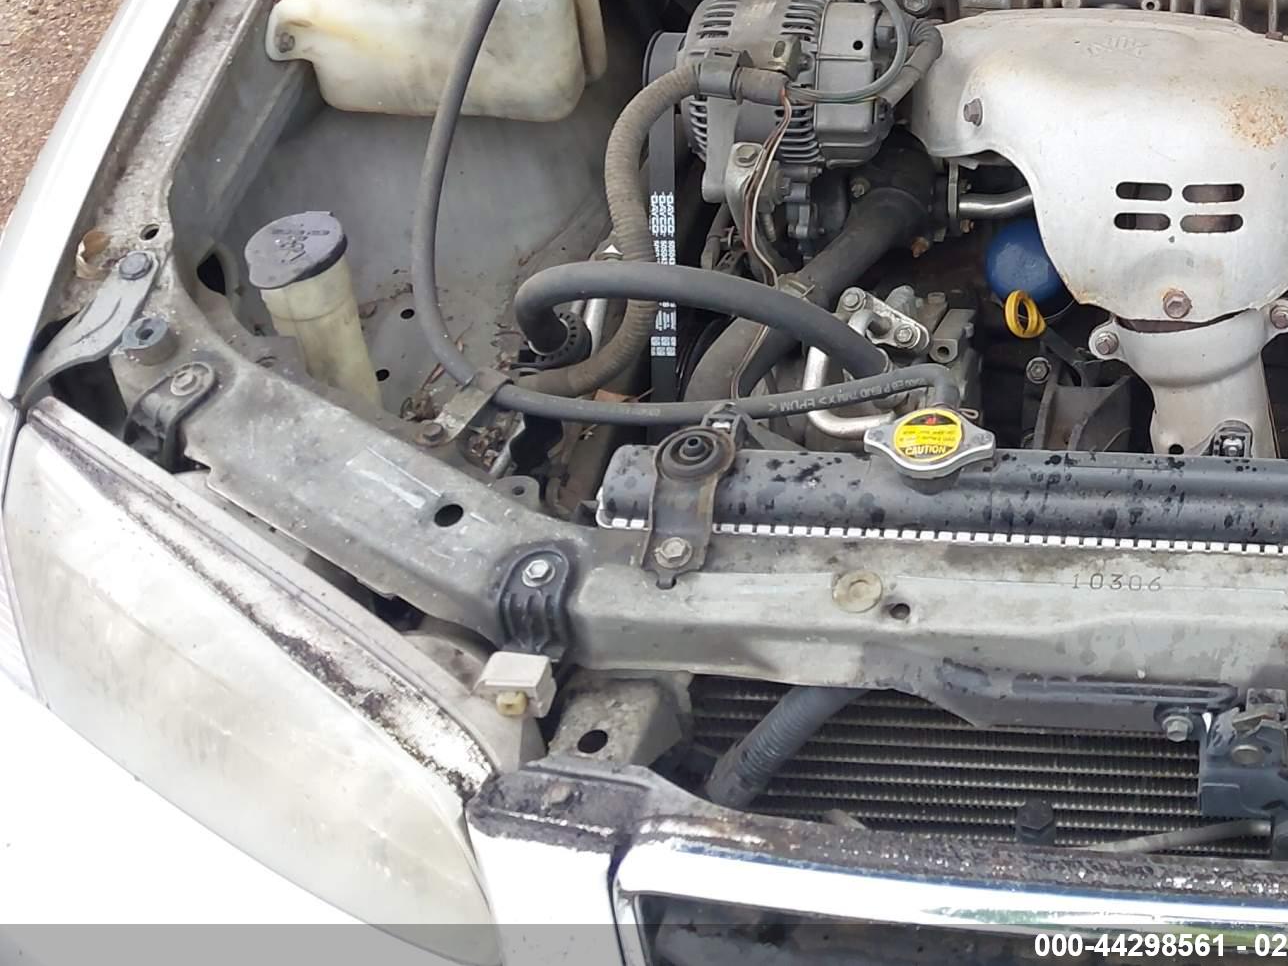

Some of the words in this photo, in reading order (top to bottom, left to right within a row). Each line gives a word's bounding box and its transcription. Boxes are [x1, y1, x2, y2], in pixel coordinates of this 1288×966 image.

[650, 194, 659, 234] DAYCO
[658, 194, 667, 234] DAYCO
[666, 194, 675, 234] DAYCO
[904, 444, 946, 455] CAUTION
[1072, 572, 1162, 592] 10306
